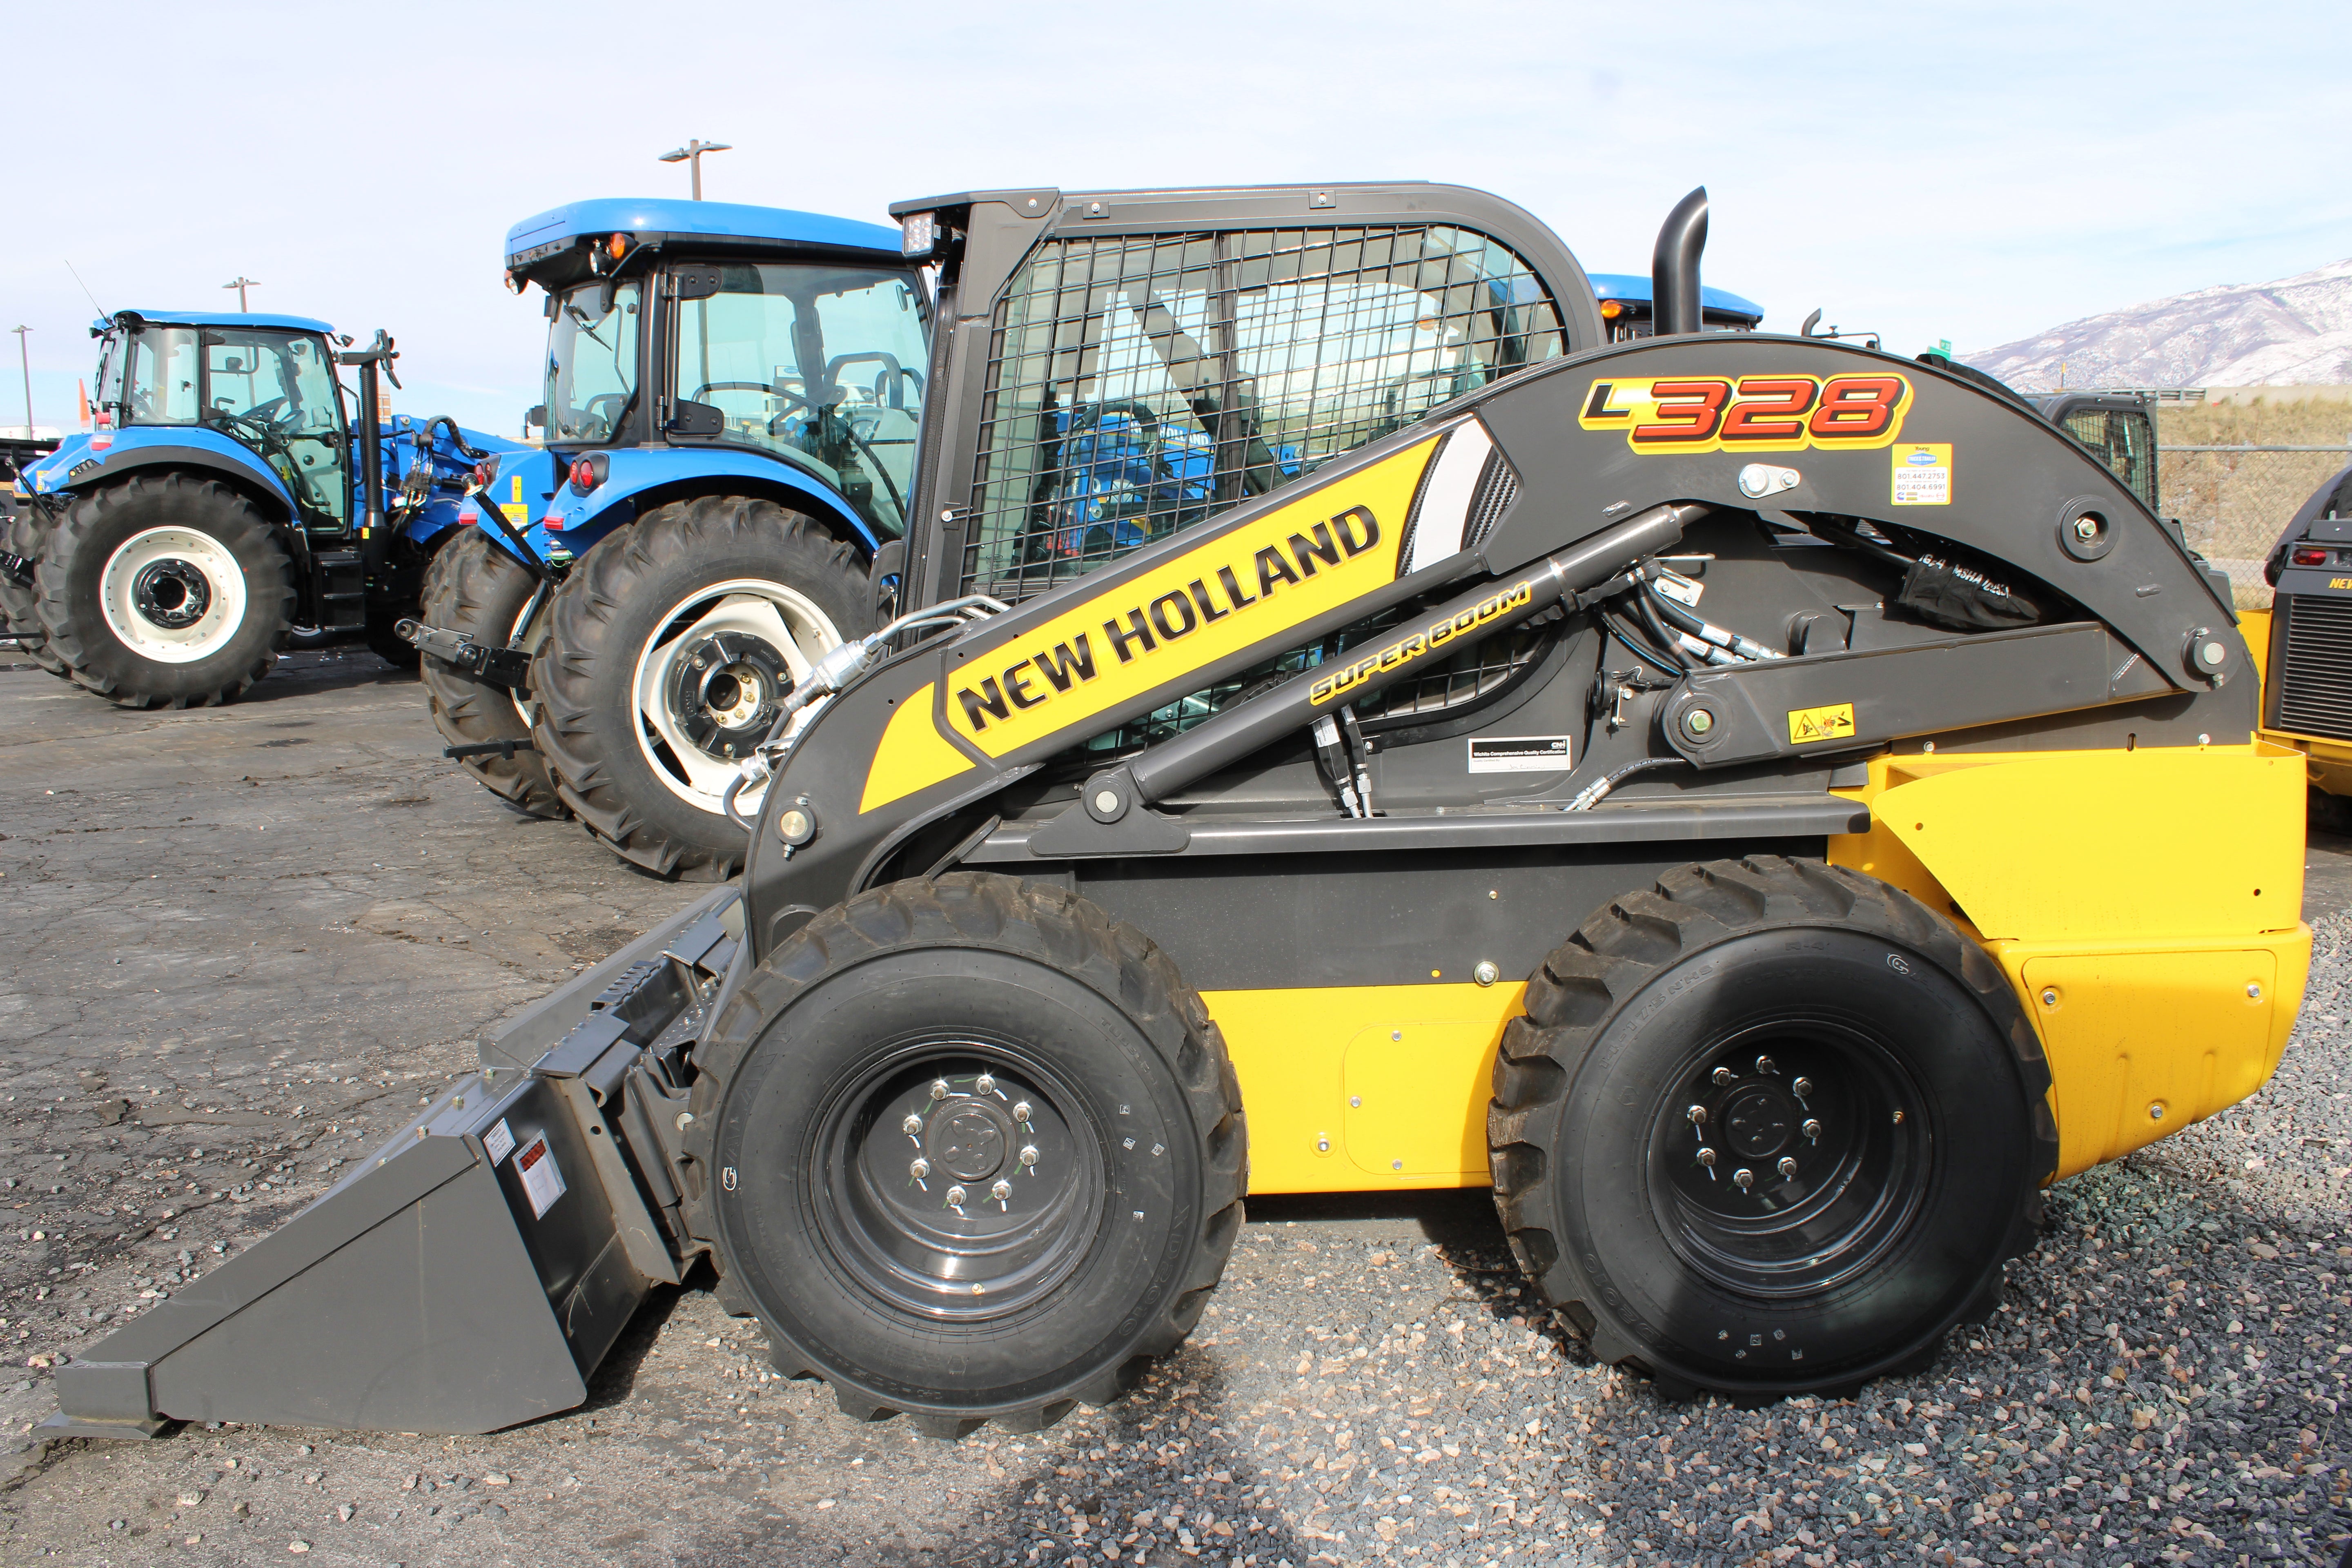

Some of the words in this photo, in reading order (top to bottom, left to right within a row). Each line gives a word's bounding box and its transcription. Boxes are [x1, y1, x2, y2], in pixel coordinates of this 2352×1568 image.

[1581, 376, 1906, 444] L328
[956, 632, 1098, 733] NEW
[1102, 505, 1381, 665] HOLLAND
[1311, 633, 1426, 705] SUPER
[1429, 581, 1531, 648] BOOM
[1667, 965, 1713, 995] NHS
[1119, 1204, 1190, 1336] XD2010
